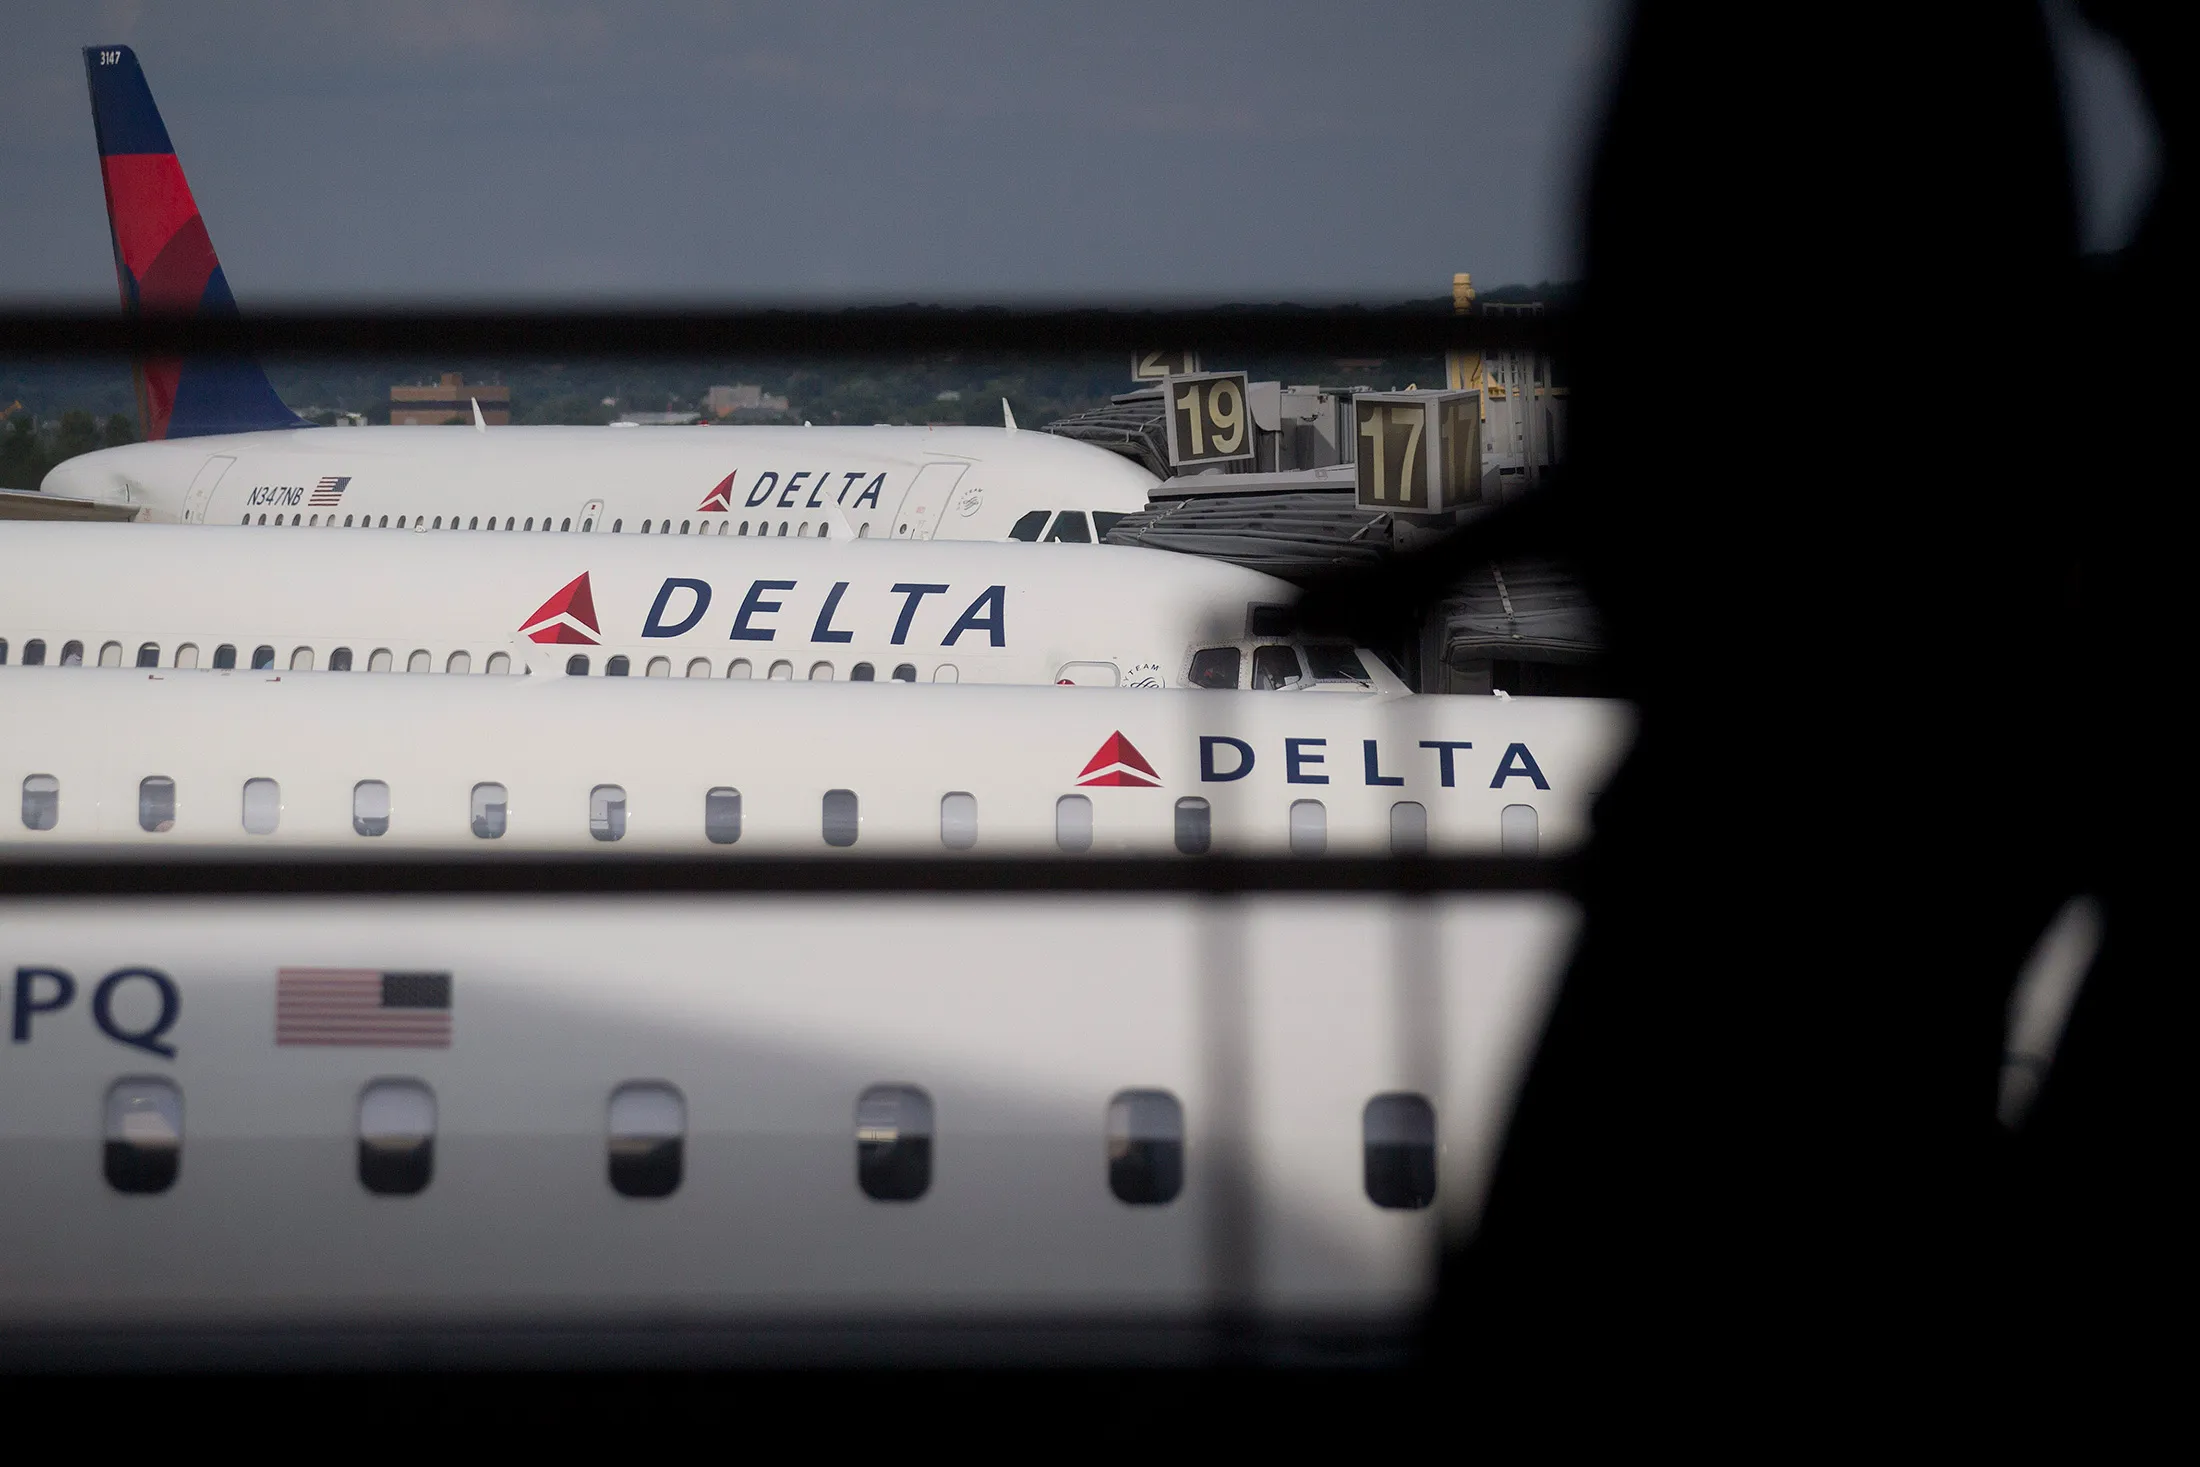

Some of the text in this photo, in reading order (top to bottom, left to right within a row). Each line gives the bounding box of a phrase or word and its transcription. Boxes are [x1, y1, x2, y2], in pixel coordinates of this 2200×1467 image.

[100, 51, 121, 65] 3147
[1177, 380, 1245, 456] 19
[1361, 406, 1425, 501] 17
[1442, 406, 1478, 500] 17
[246, 487, 304, 506] N347NB
[744, 471, 888, 509] DELTA
[641, 577, 1007, 648] DELTA
[1199, 735, 1551, 790] DELTA
[0, 965, 182, 1060] PQ
